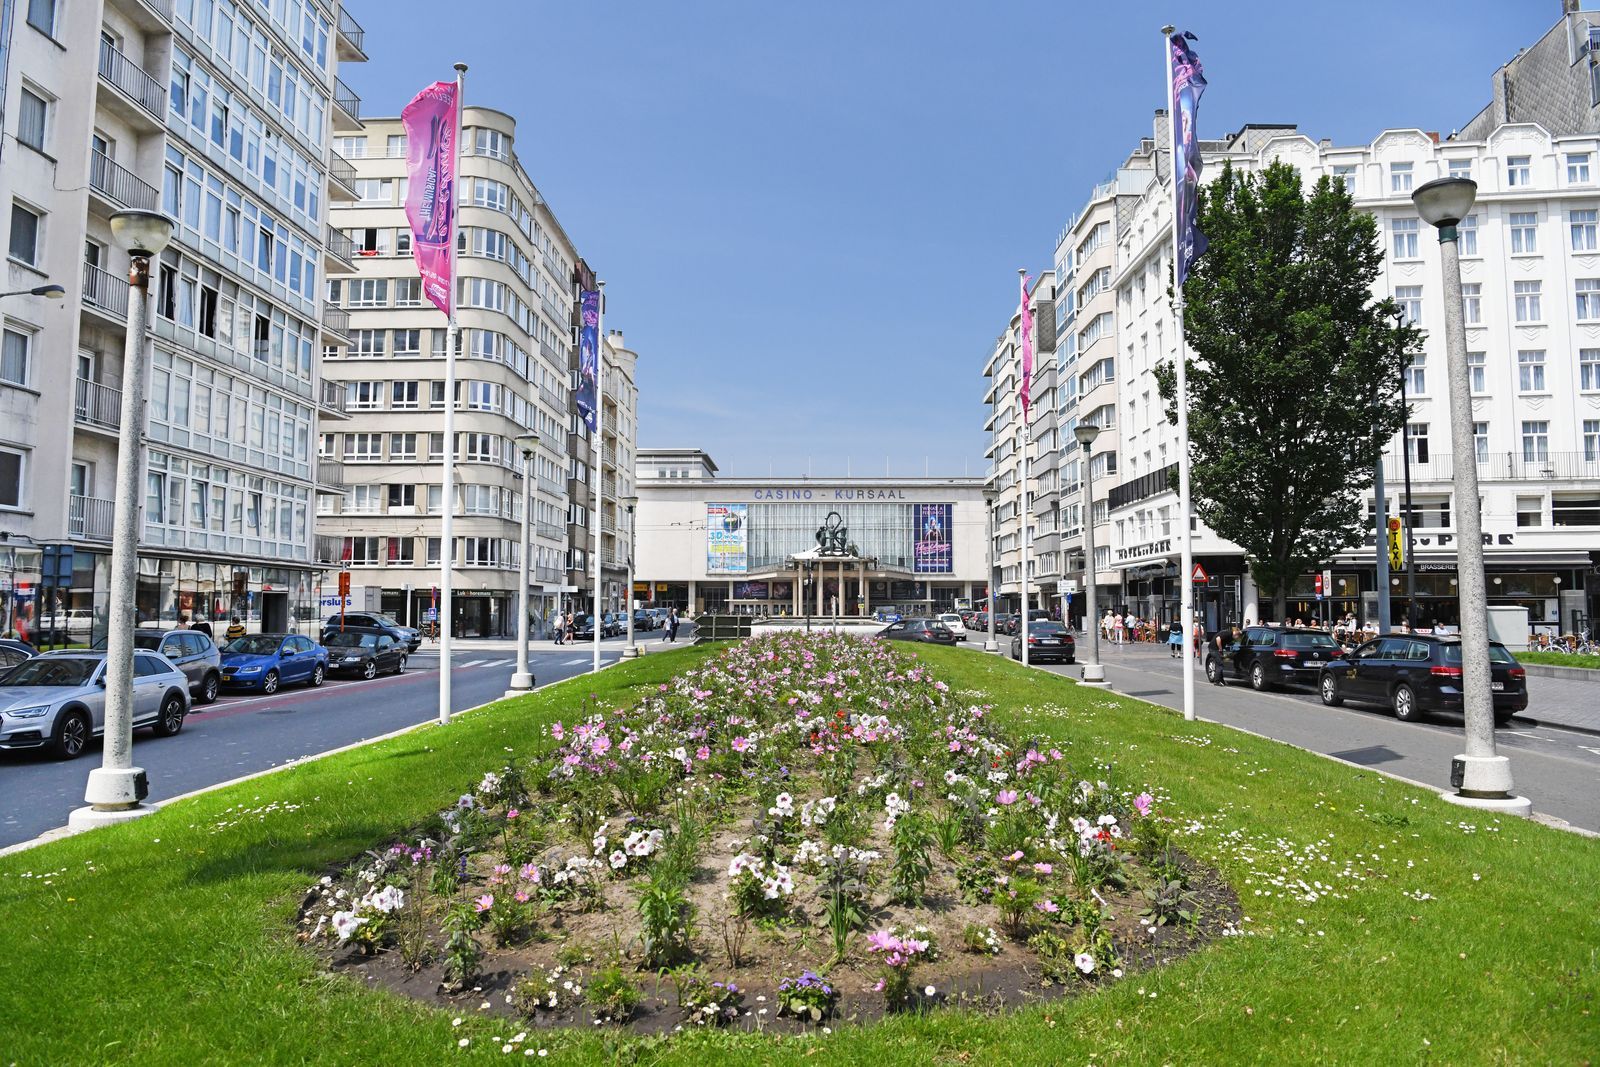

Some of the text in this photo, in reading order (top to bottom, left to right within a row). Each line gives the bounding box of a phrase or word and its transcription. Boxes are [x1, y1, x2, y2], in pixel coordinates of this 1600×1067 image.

[754, 489, 812, 499] CASINO
[835, 489, 905, 499] KURSAAL
[1438, 534, 1513, 546] PRC
[1118, 547, 1142, 560] HOTEL
